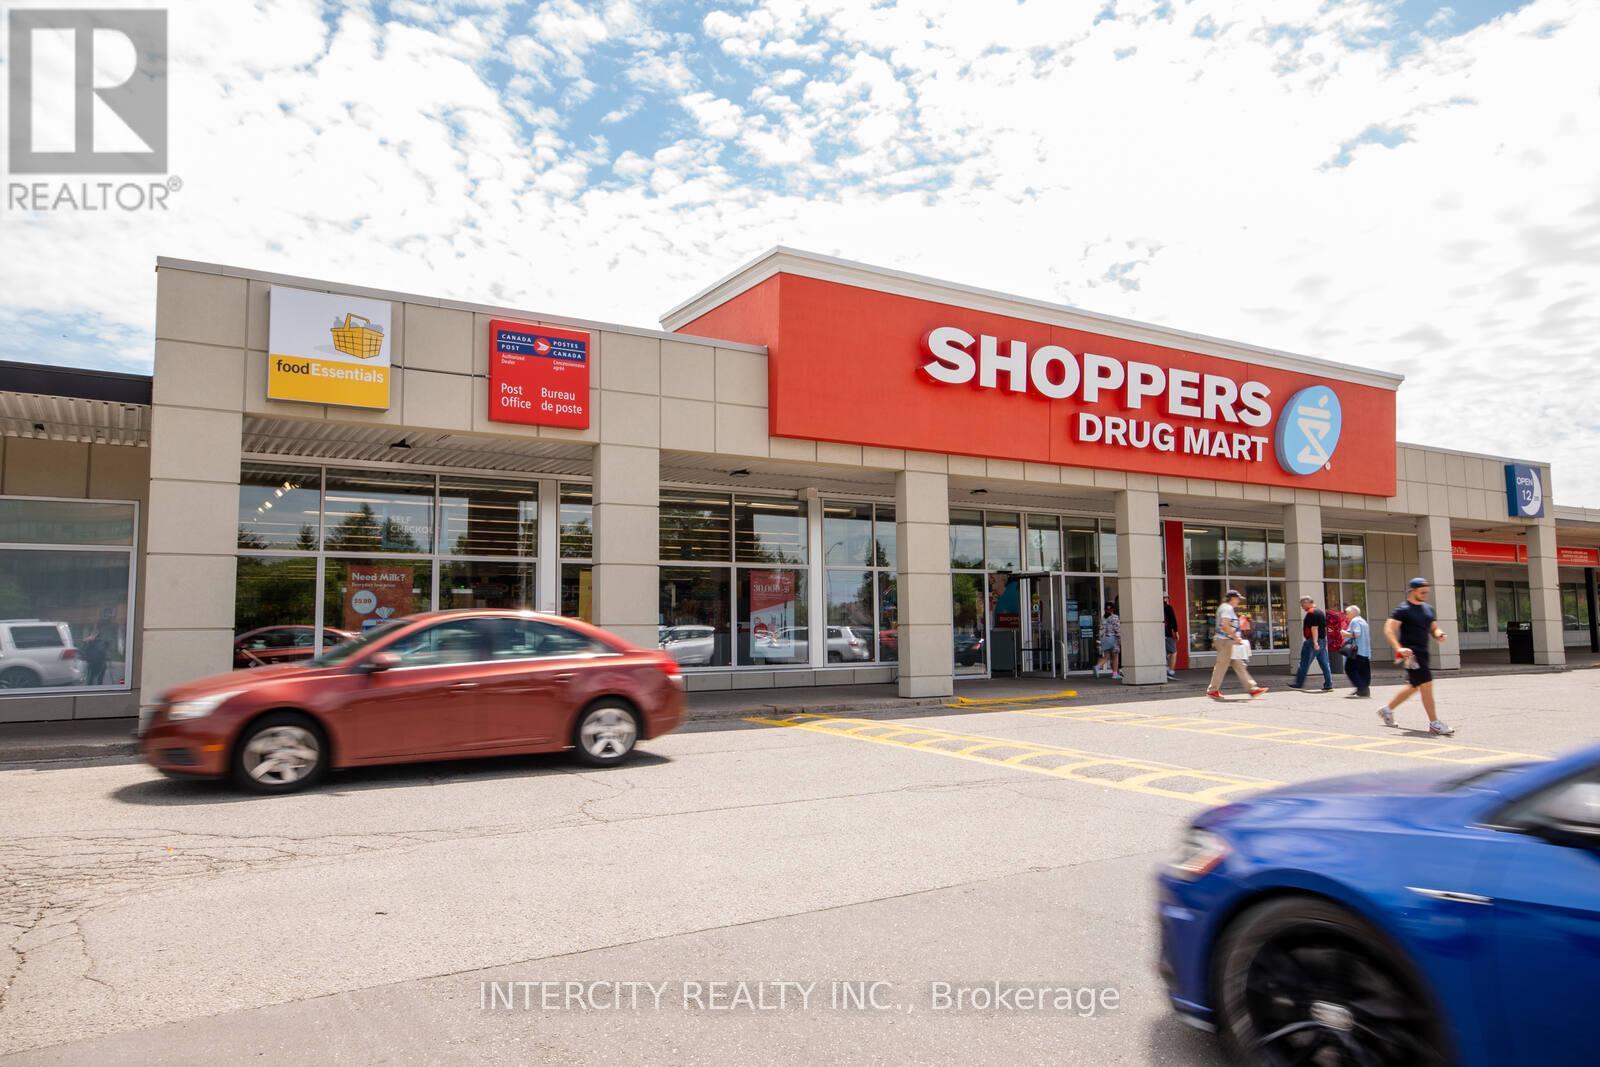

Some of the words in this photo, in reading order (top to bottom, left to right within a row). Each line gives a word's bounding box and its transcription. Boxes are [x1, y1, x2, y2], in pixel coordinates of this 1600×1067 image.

[501, 333, 532, 343] CANADA
[553, 341, 579, 349] POSTES
[553, 351, 582, 359] CANADA
[922, 326, 1272, 428] SHOPPERS
[501, 383, 523, 395] Post
[541, 387, 576, 401] Bureau
[501, 396, 532, 409] Office
[541, 400, 553, 411] de
[555, 403, 582, 415] poste
[1078, 412, 1175, 452] DRUG
[1184, 426, 1269, 462] MART
[1516, 477, 1533, 486] OPEN
[1522, 489, 1532, 501] 12
[352, 572, 378, 581] Need
